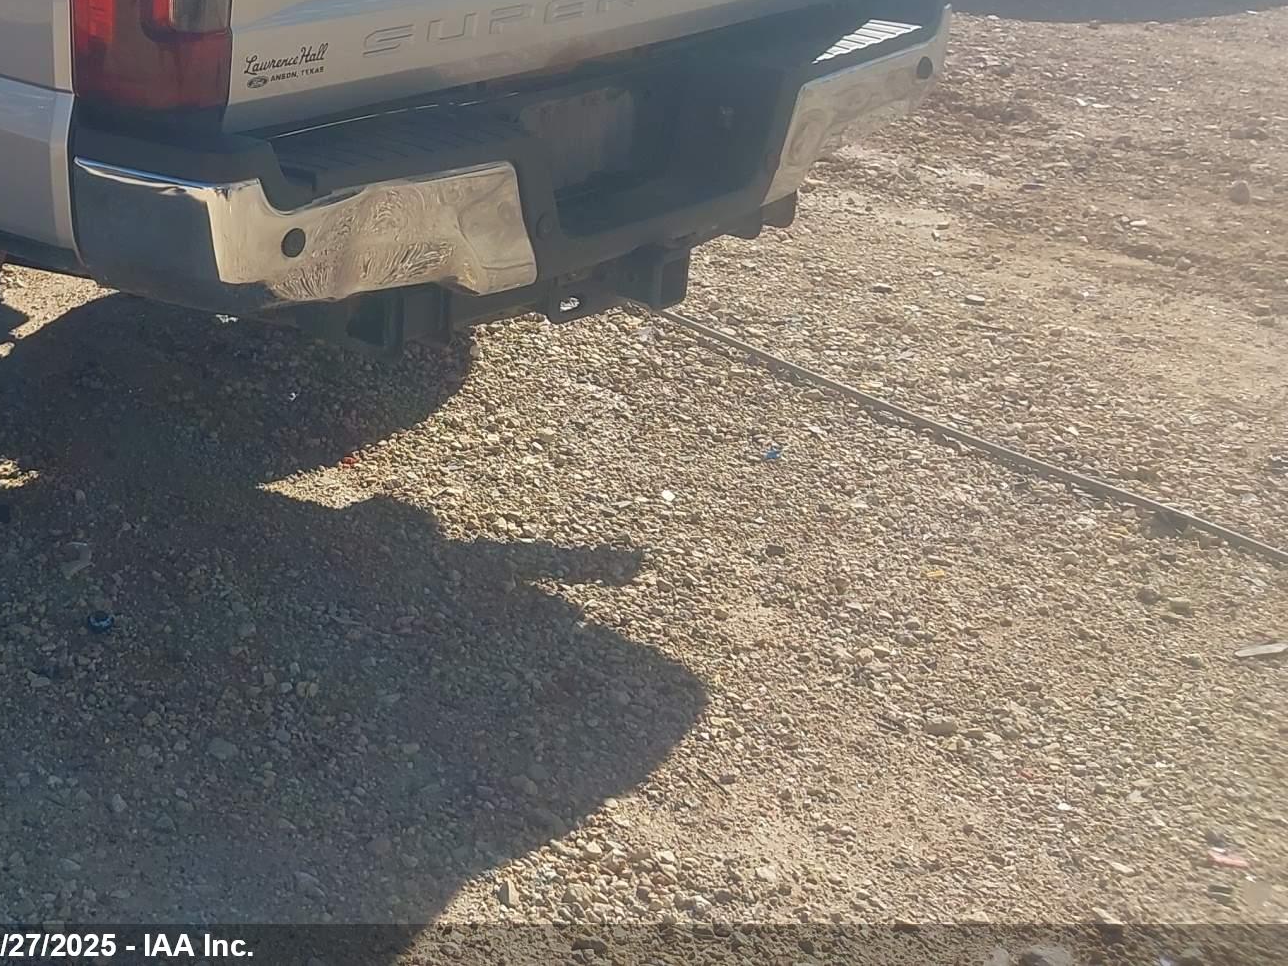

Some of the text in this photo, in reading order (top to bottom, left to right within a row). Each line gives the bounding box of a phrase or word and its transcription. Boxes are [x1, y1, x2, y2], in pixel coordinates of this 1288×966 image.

[244, 42, 329, 76] Lawrence Hall
[301, 66, 324, 76] TEXAS
